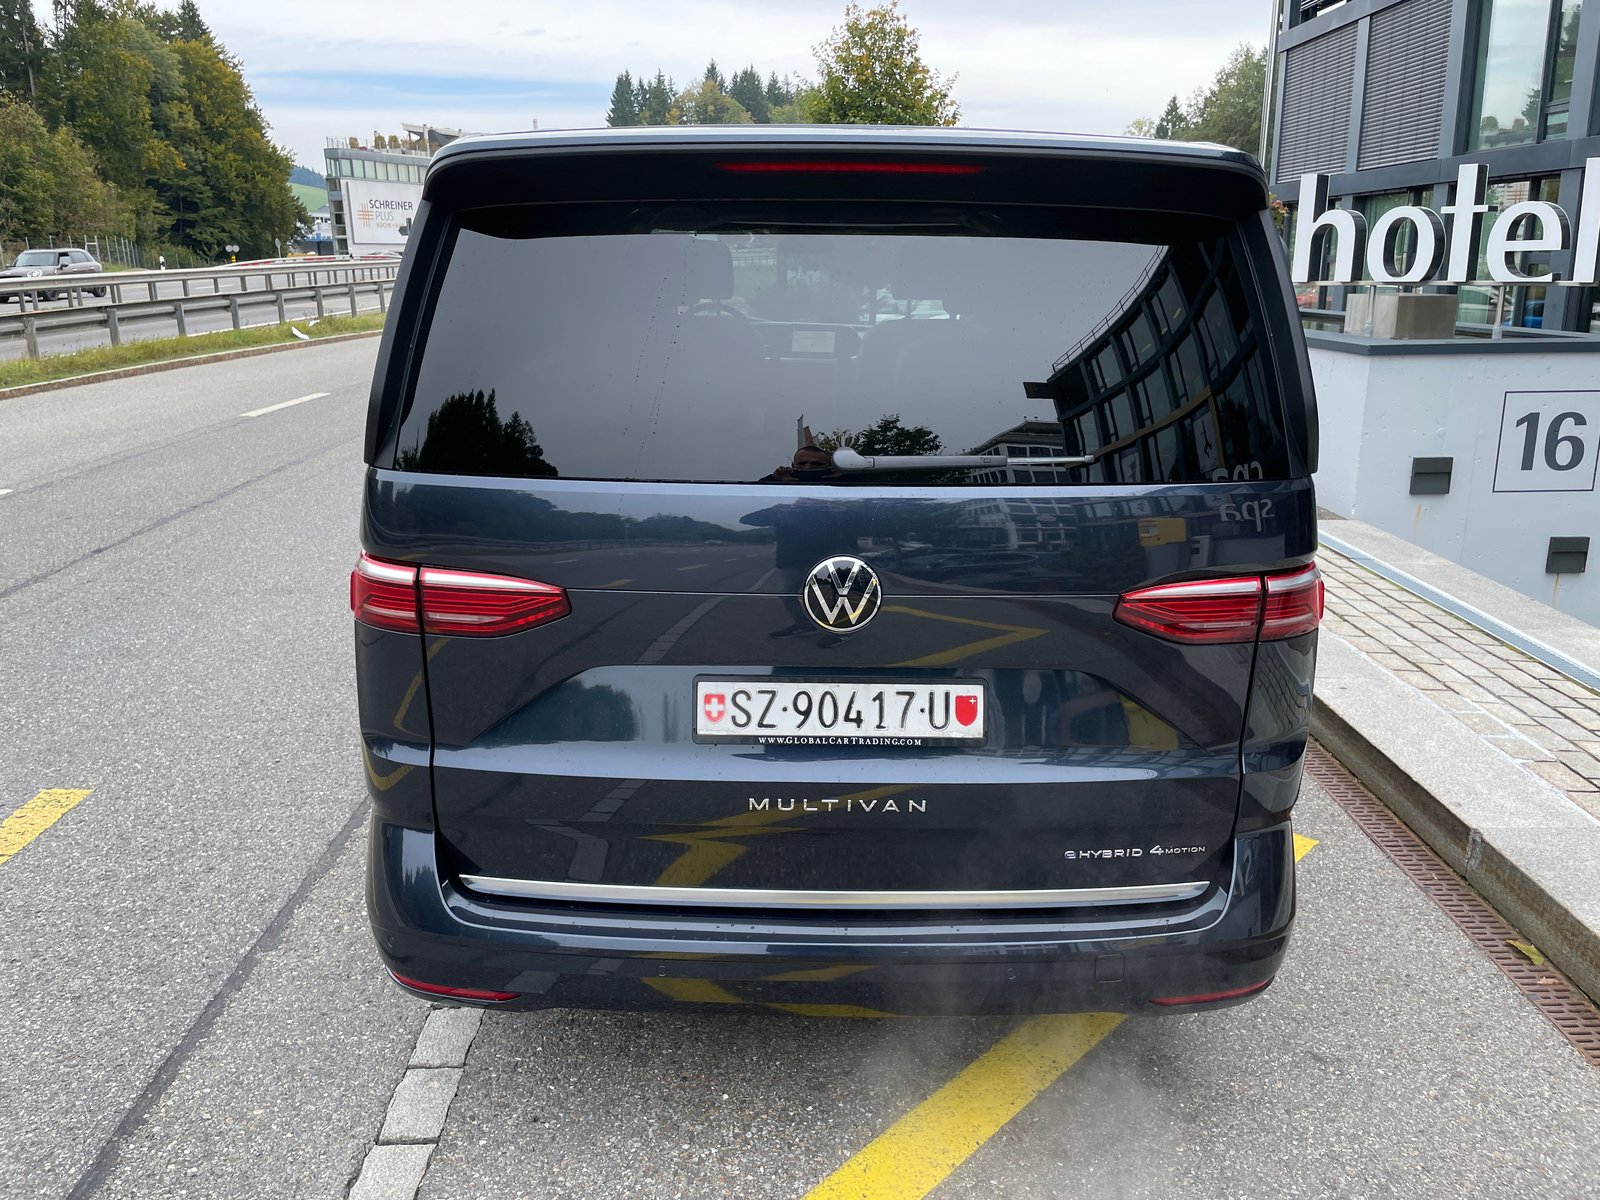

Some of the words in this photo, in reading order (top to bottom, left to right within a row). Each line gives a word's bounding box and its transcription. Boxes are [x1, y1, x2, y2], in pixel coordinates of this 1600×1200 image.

[368, 199, 414, 211] SCHREINER
[374, 210, 394, 221] PLUS
[1292, 157, 1600, 283] hotel
[1515, 411, 1588, 471] 16
[748, 797, 927, 813] MULTIVAN
[1150, 844, 1206, 857] 4MOTION
